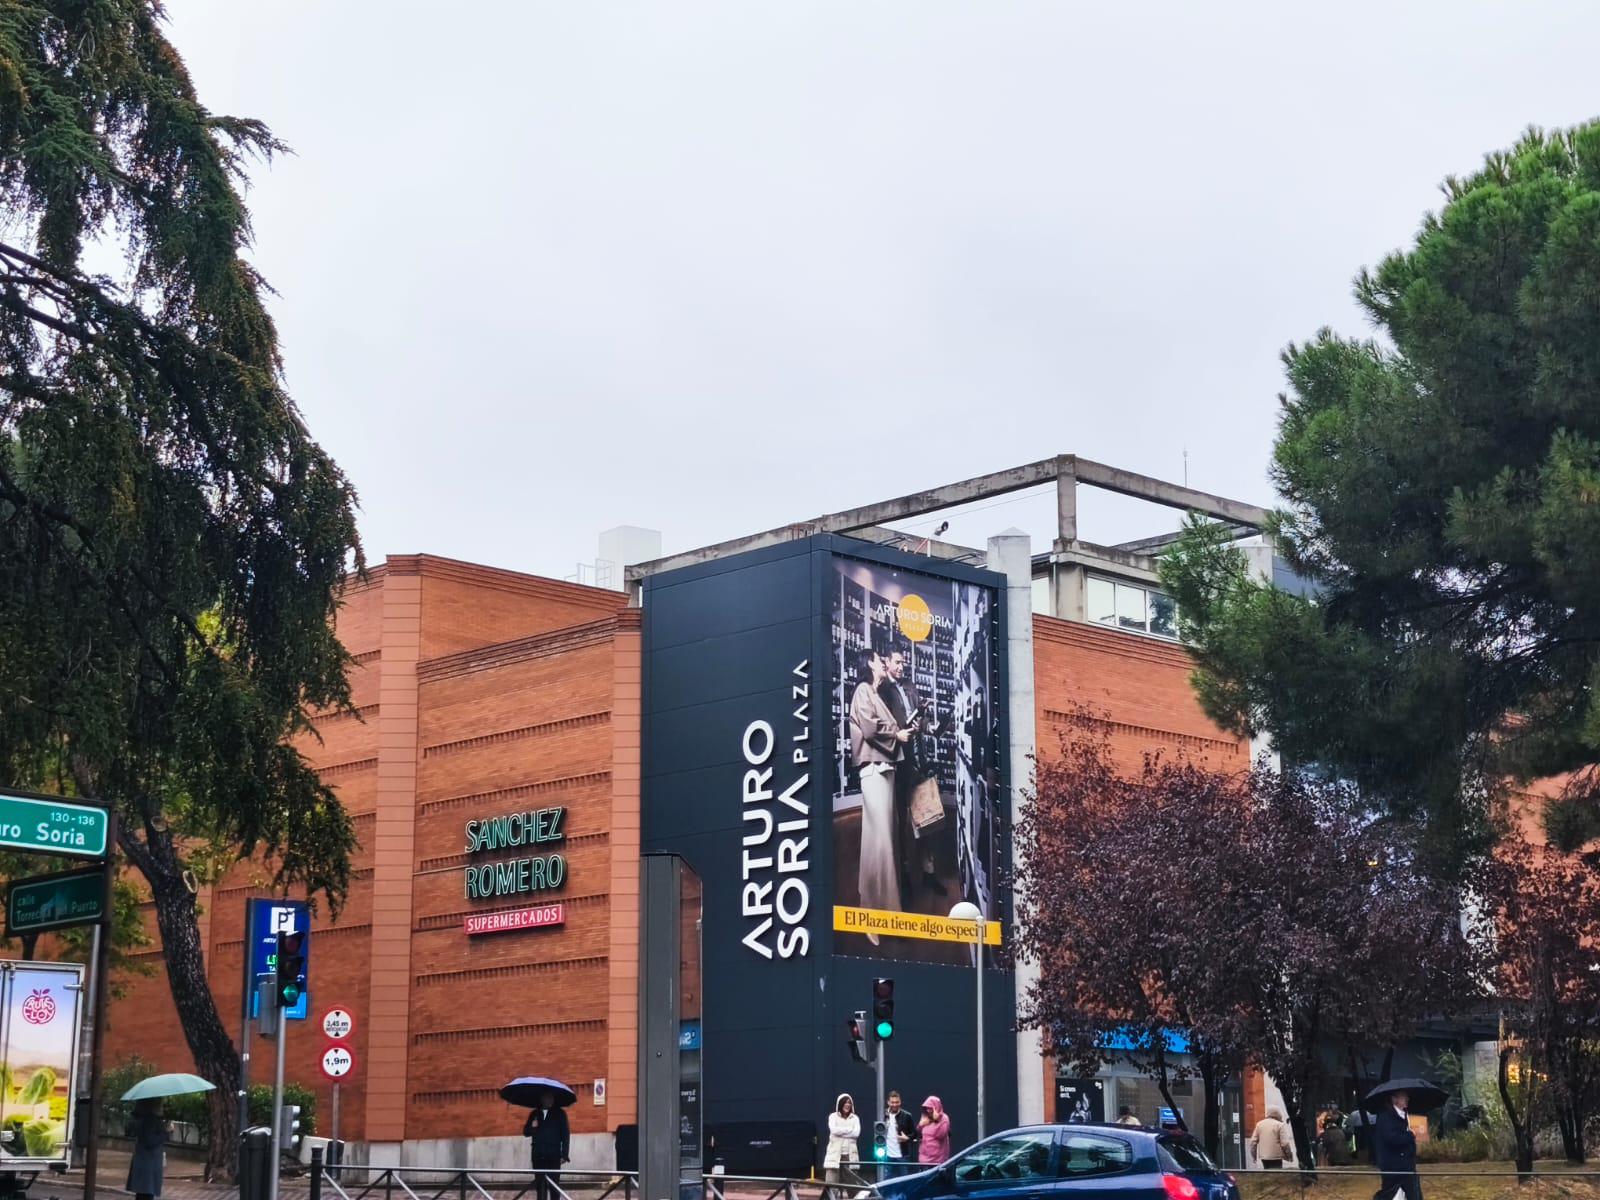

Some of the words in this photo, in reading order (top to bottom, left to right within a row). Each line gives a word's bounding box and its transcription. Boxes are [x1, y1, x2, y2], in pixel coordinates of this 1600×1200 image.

[875, 603, 920, 622] ARTURO
[920, 612, 953, 630] SORIA
[792, 658, 809, 764] PLAZA
[0, 823, 21, 838] ro
[36, 822, 85, 845] Soria
[464, 806, 563, 853] SANCHEZ
[742, 718, 774, 960] ARTURO
[464, 853, 564, 899] ROMERO
[776, 772, 810, 959] SORIA
[467, 907, 558, 932] SUPERMERCADOS
[844, 910, 857, 926] El
[858, 913, 889, 930] Plaza
[891, 916, 918, 932] tiene
[919, 919, 944, 938] algo
[945, 923, 988, 939] especil
